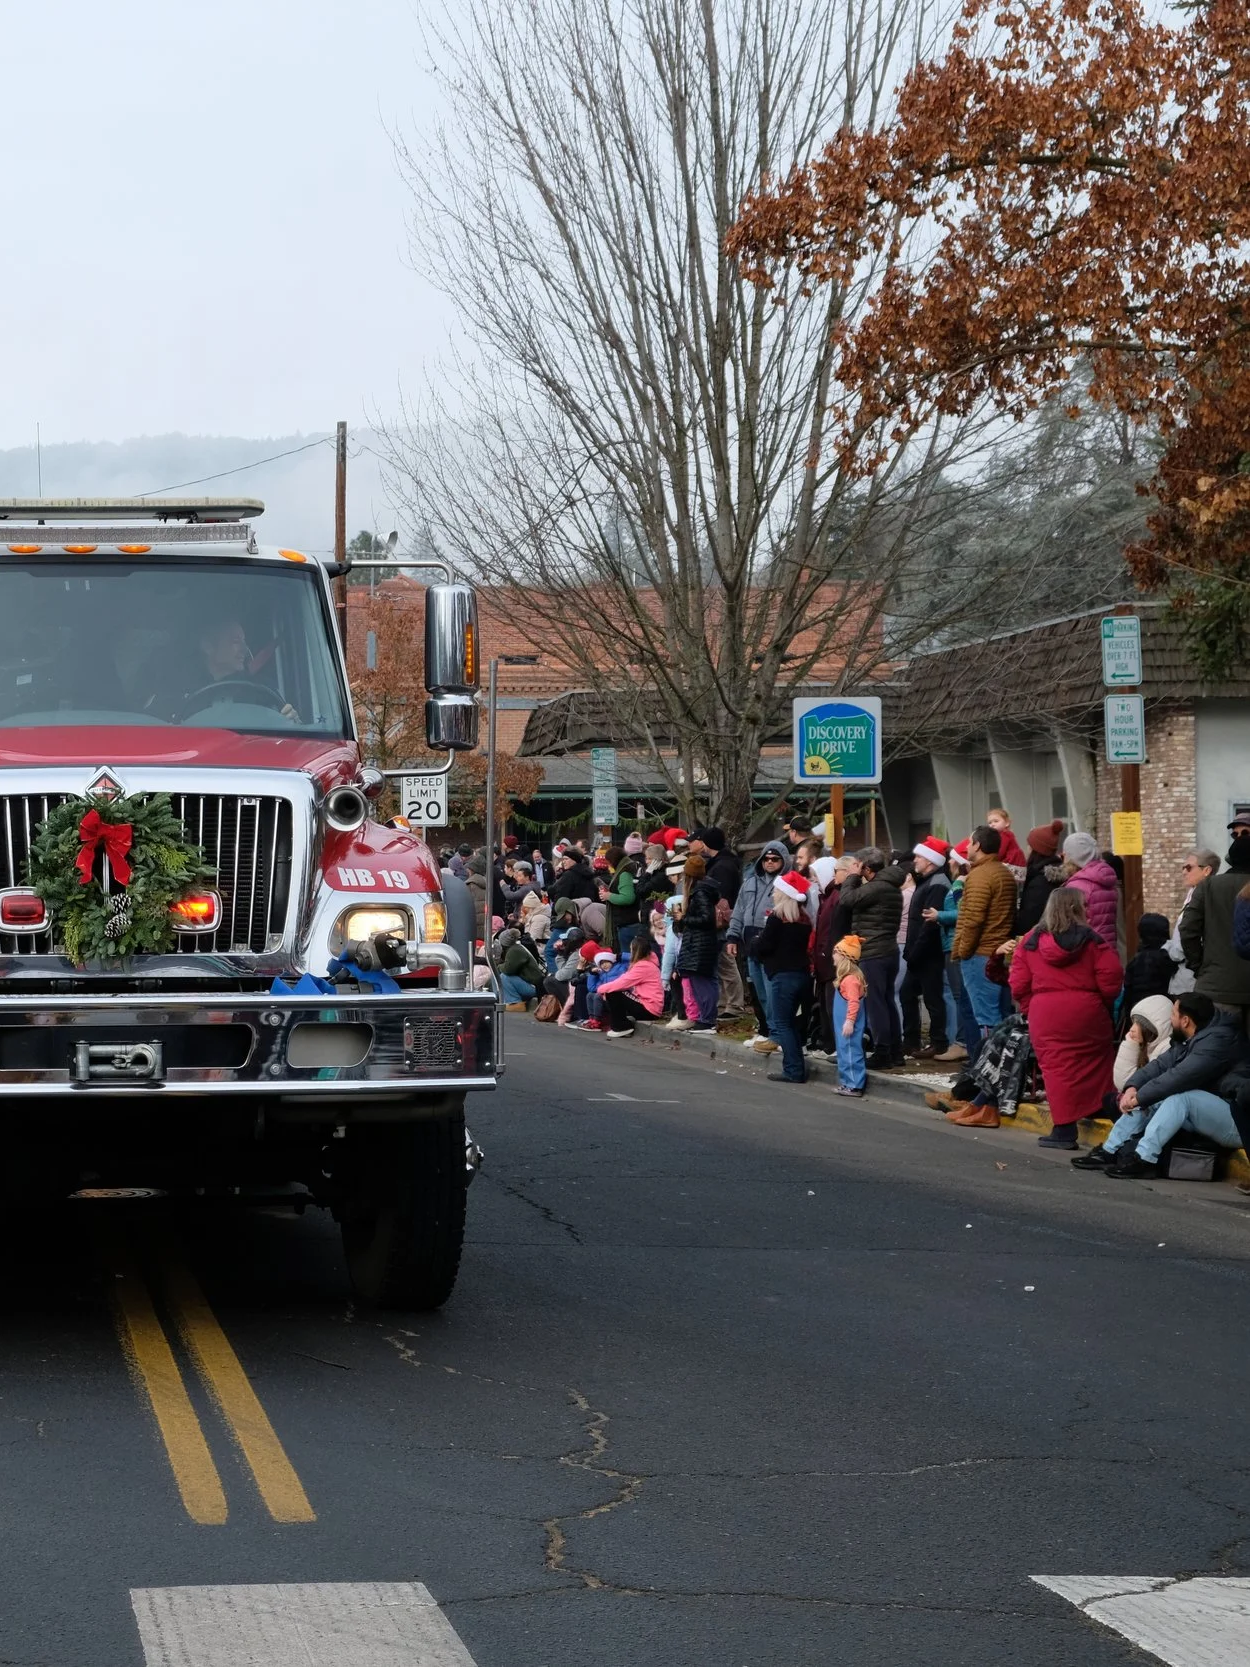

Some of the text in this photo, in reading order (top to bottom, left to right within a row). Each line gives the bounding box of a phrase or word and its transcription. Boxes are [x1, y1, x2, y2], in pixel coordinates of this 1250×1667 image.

[1114, 622, 1138, 632] PARKING
[1108, 639, 1136, 649] VEHICLES
[1116, 703, 1131, 711] TWO
[1114, 714, 1135, 724] HOUR
[808, 725, 868, 740] DISCOVERY
[1110, 727, 1139, 736] PARKING
[821, 740, 857, 753] DRIVE
[406, 777, 443, 787] SPEED
[410, 789, 439, 798] LIMIT
[407, 800, 442, 820] 20
[337, 867, 410, 890] HB 19
